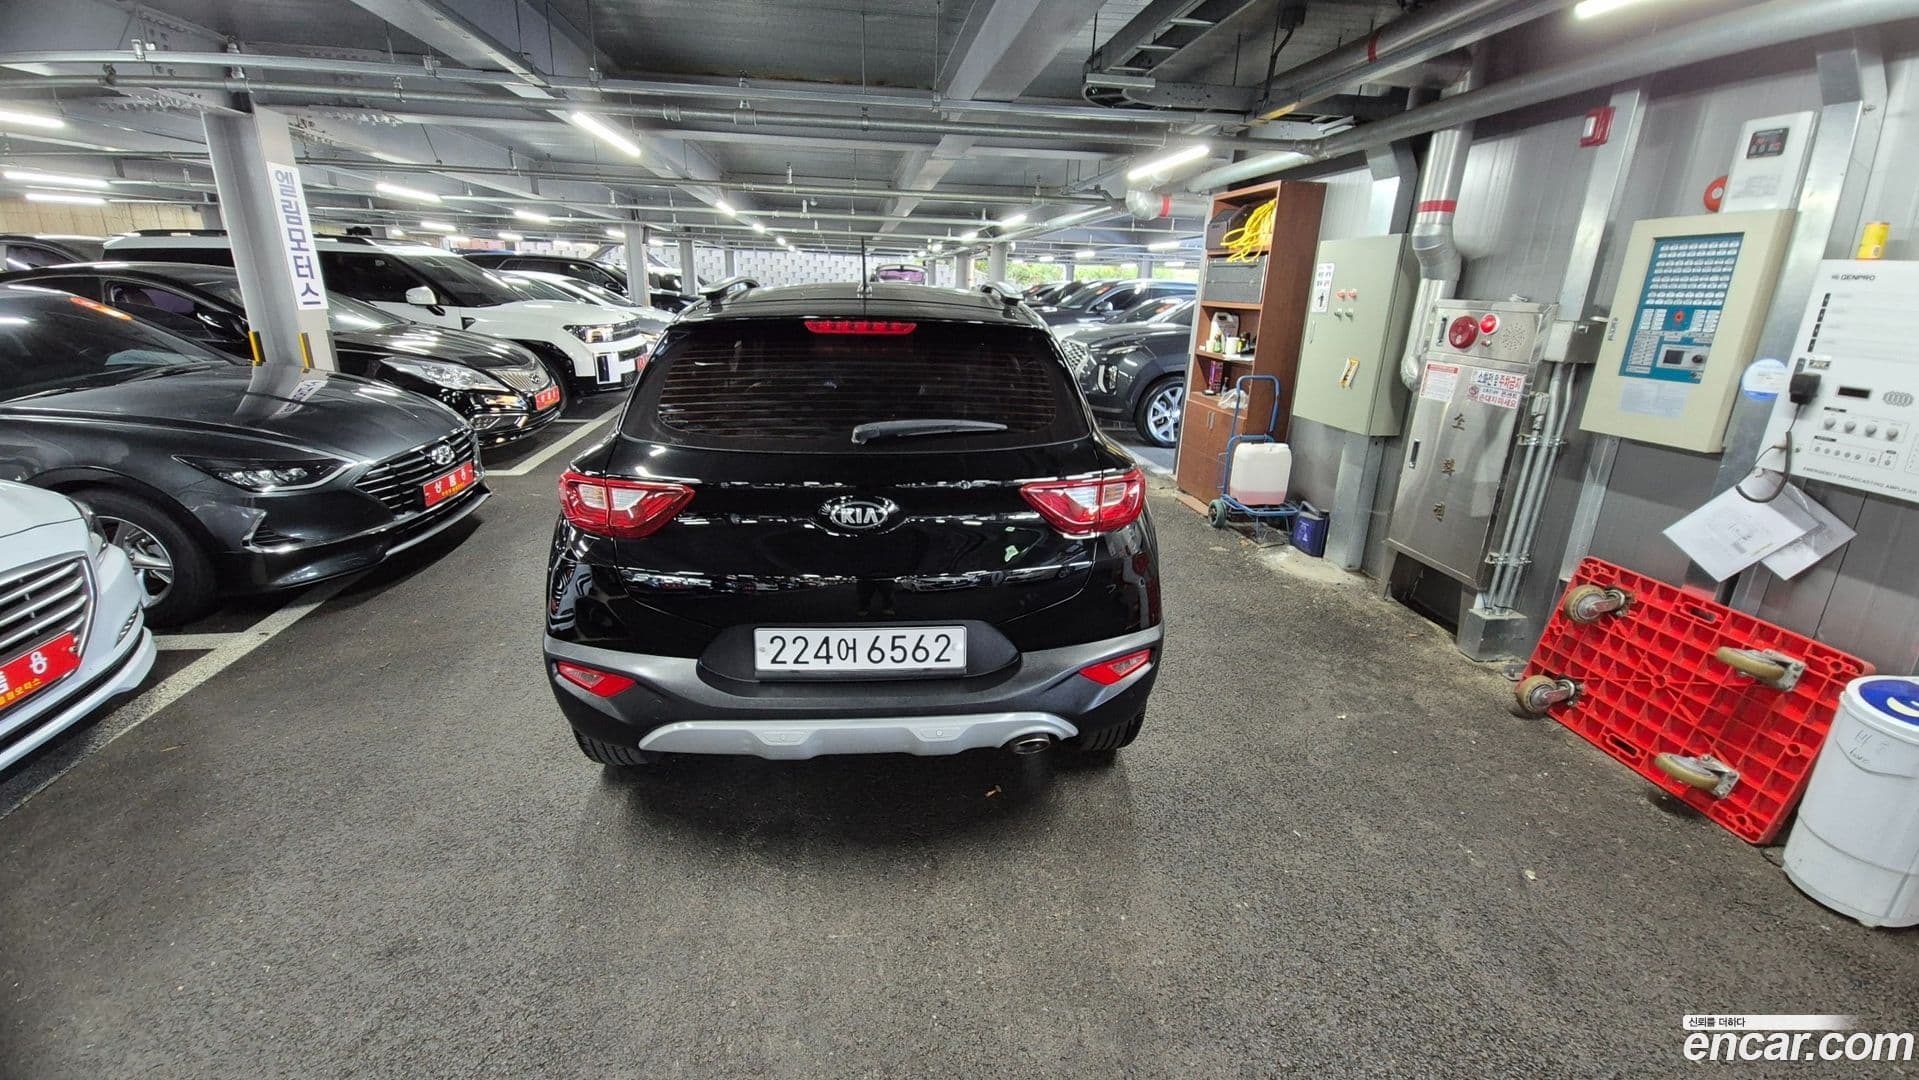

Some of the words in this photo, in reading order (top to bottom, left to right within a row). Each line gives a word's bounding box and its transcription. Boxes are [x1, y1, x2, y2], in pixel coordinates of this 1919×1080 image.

[274, 170, 322, 305] 엘림모터스
[841, 507, 879, 524] KIA
[769, 635, 857, 665] 224어
[867, 633, 951, 664] 6562
